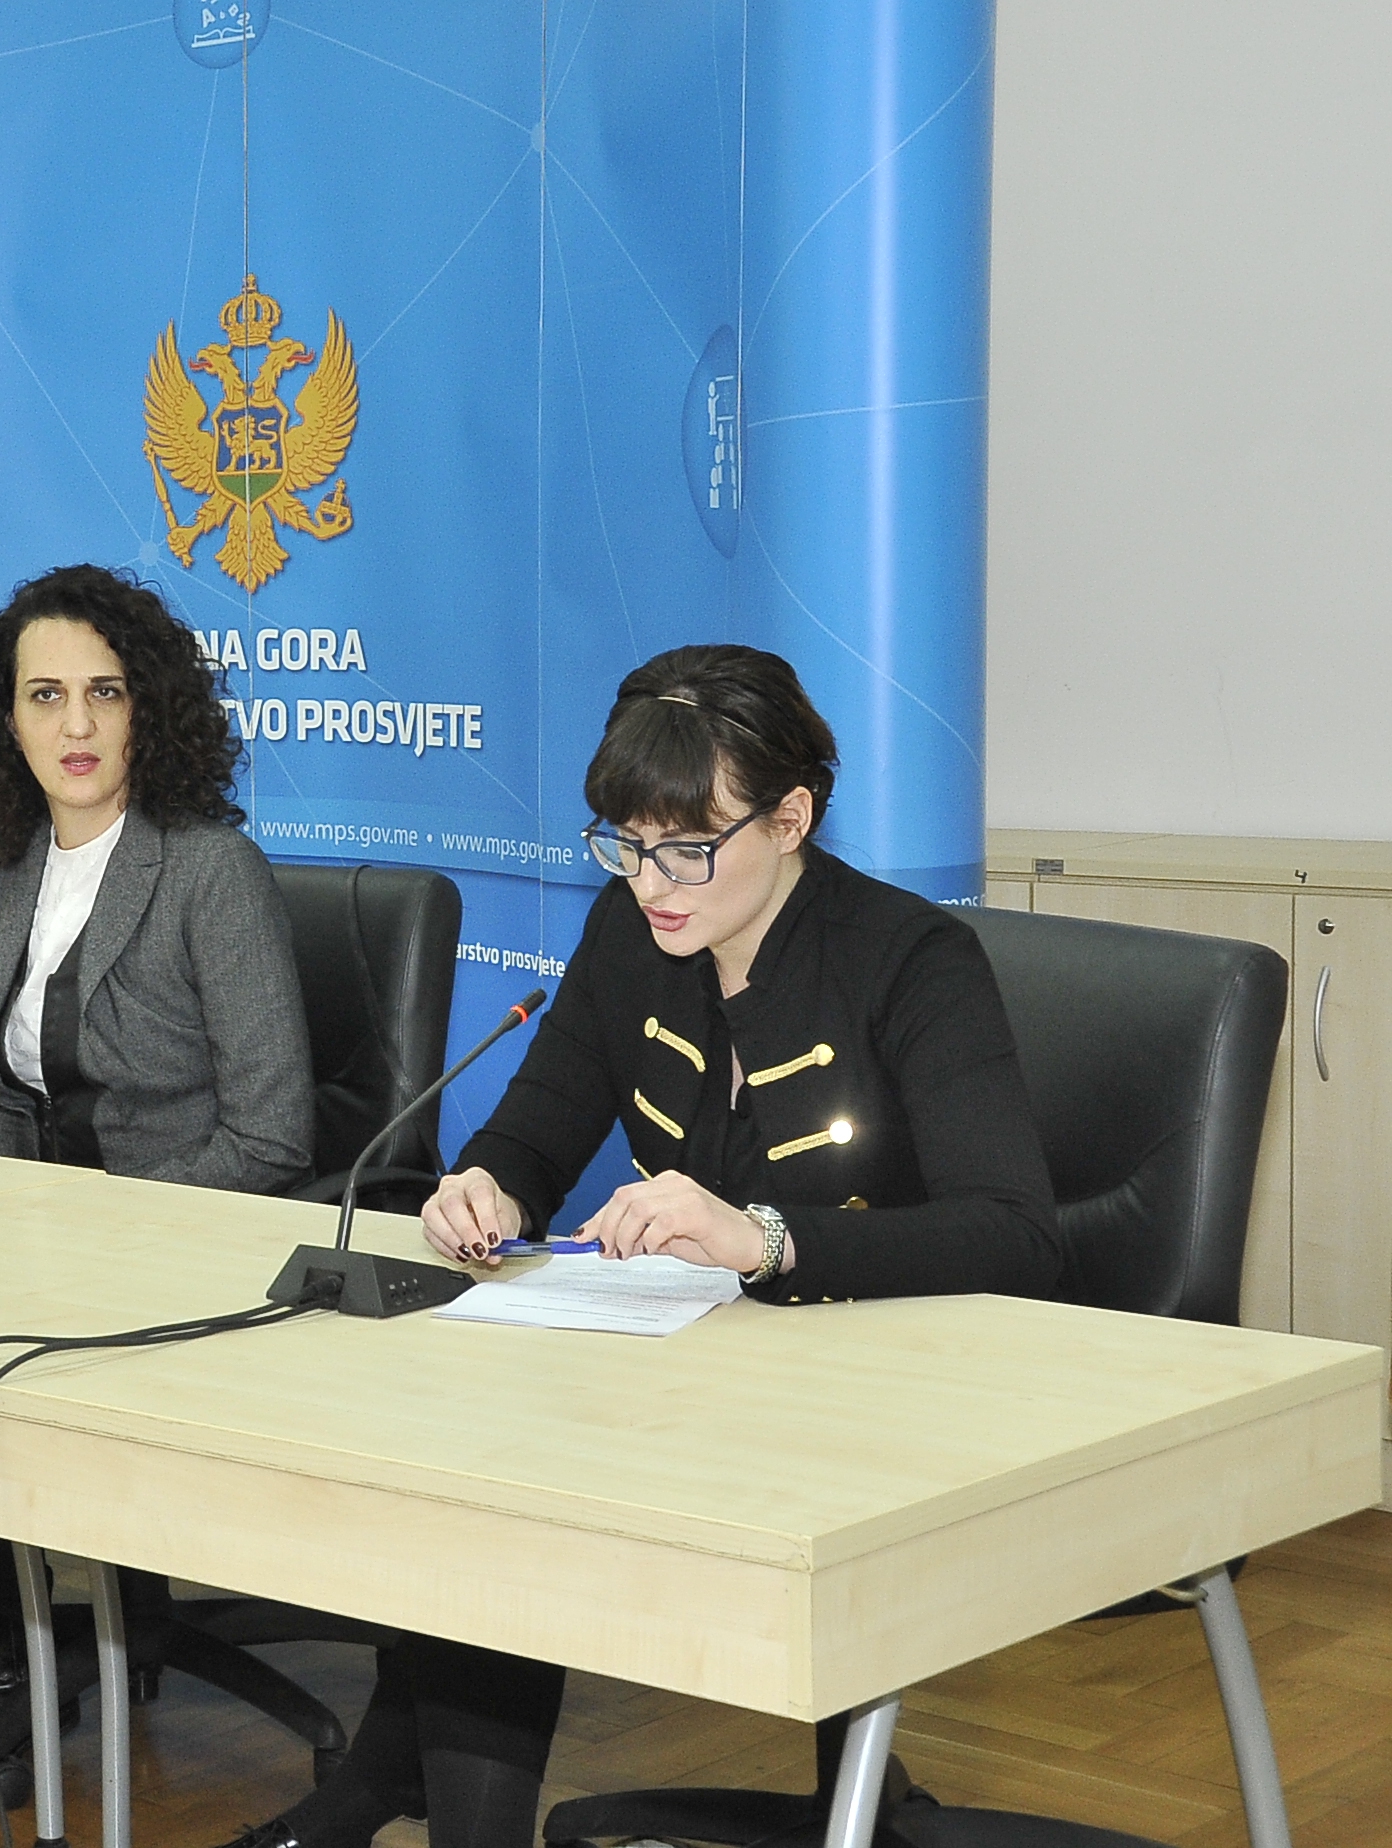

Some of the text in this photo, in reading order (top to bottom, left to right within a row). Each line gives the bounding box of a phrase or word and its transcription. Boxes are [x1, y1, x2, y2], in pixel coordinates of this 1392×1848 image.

[256, 628, 367, 671] GORA
[296, 698, 482, 757] PROSVJETE
[260, 820, 419, 848] www.mps.gov.me
[441, 832, 573, 865] www.mps.gov.me
[502, 948, 566, 978] prosvjete
